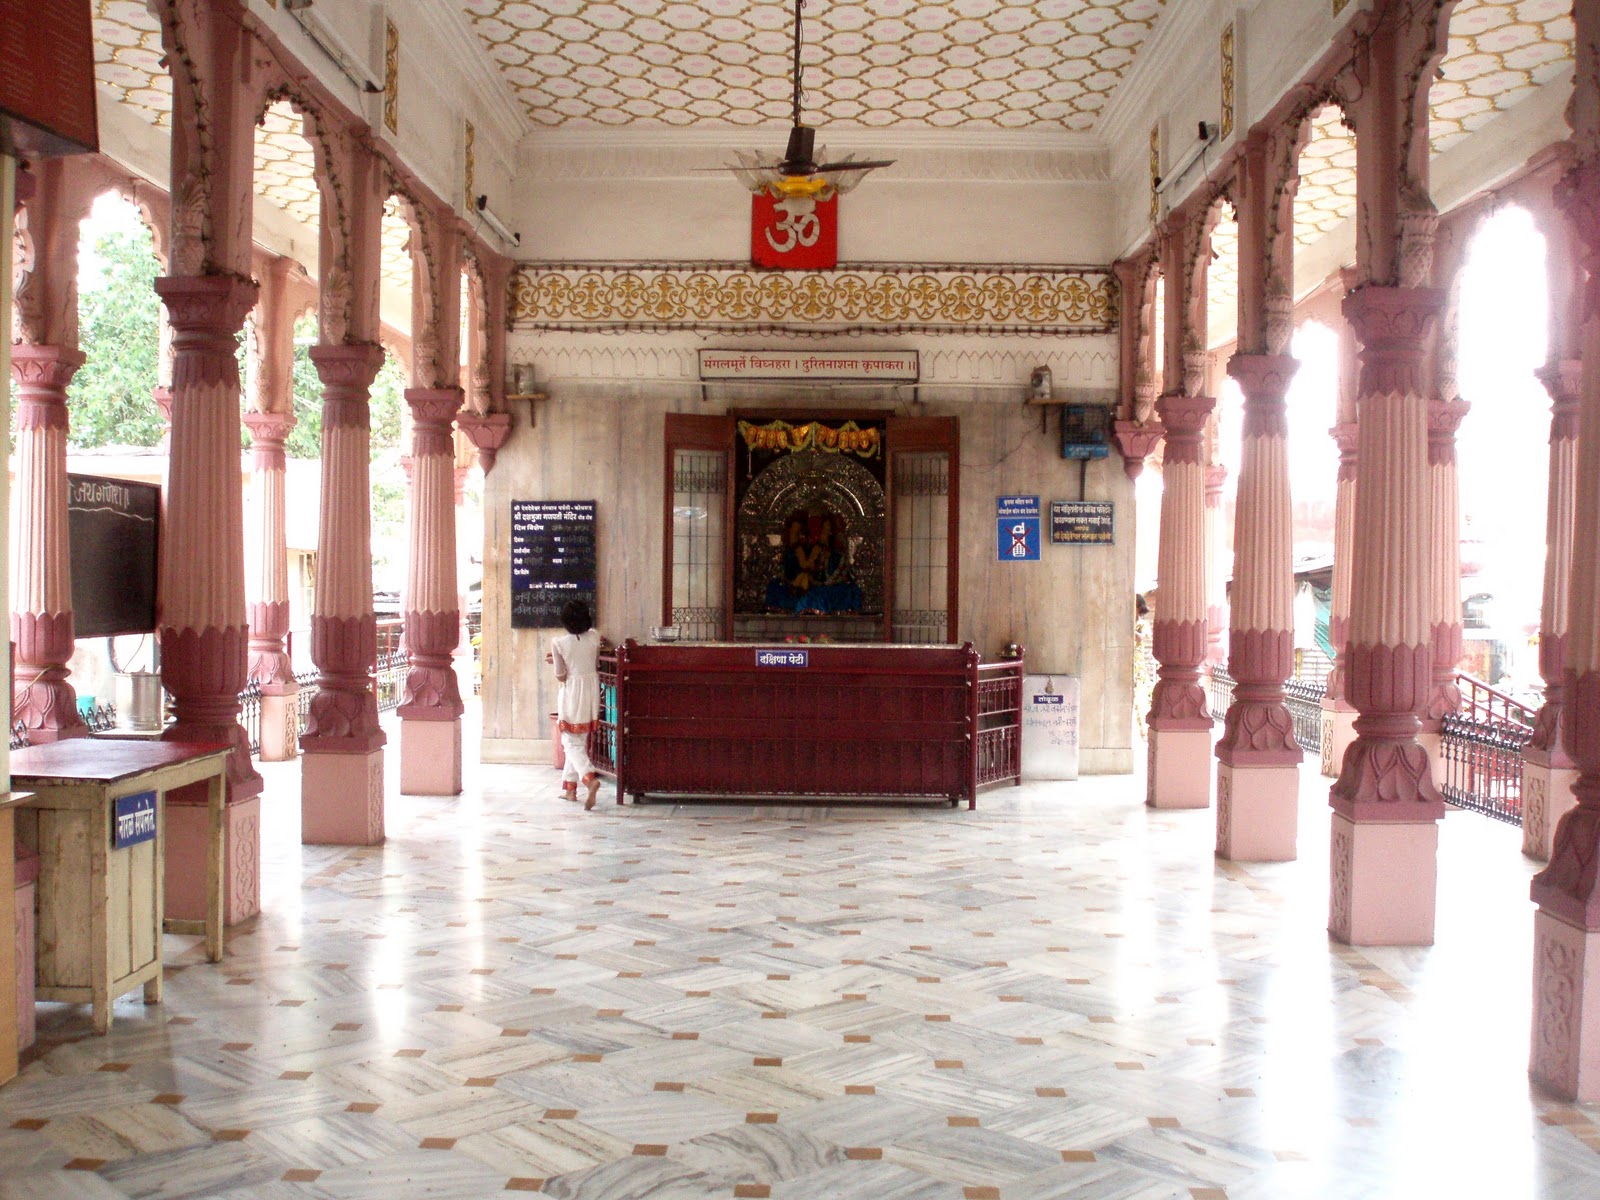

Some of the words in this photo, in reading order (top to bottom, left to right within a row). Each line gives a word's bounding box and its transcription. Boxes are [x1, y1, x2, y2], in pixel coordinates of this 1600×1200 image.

[704, 356, 746, 372] मंगलमूर्ते
[750, 356, 791, 370] विघ्नहरा
[802, 357, 858, 373] दुरितनाशना
[862, 360, 904, 373] कृपाकरा
[563, 511, 577, 520] मंदिर
[760, 653, 787, 665] दक्षिणा
[788, 653, 804, 665] पेटी
[118, 813, 134, 840] नारळ
